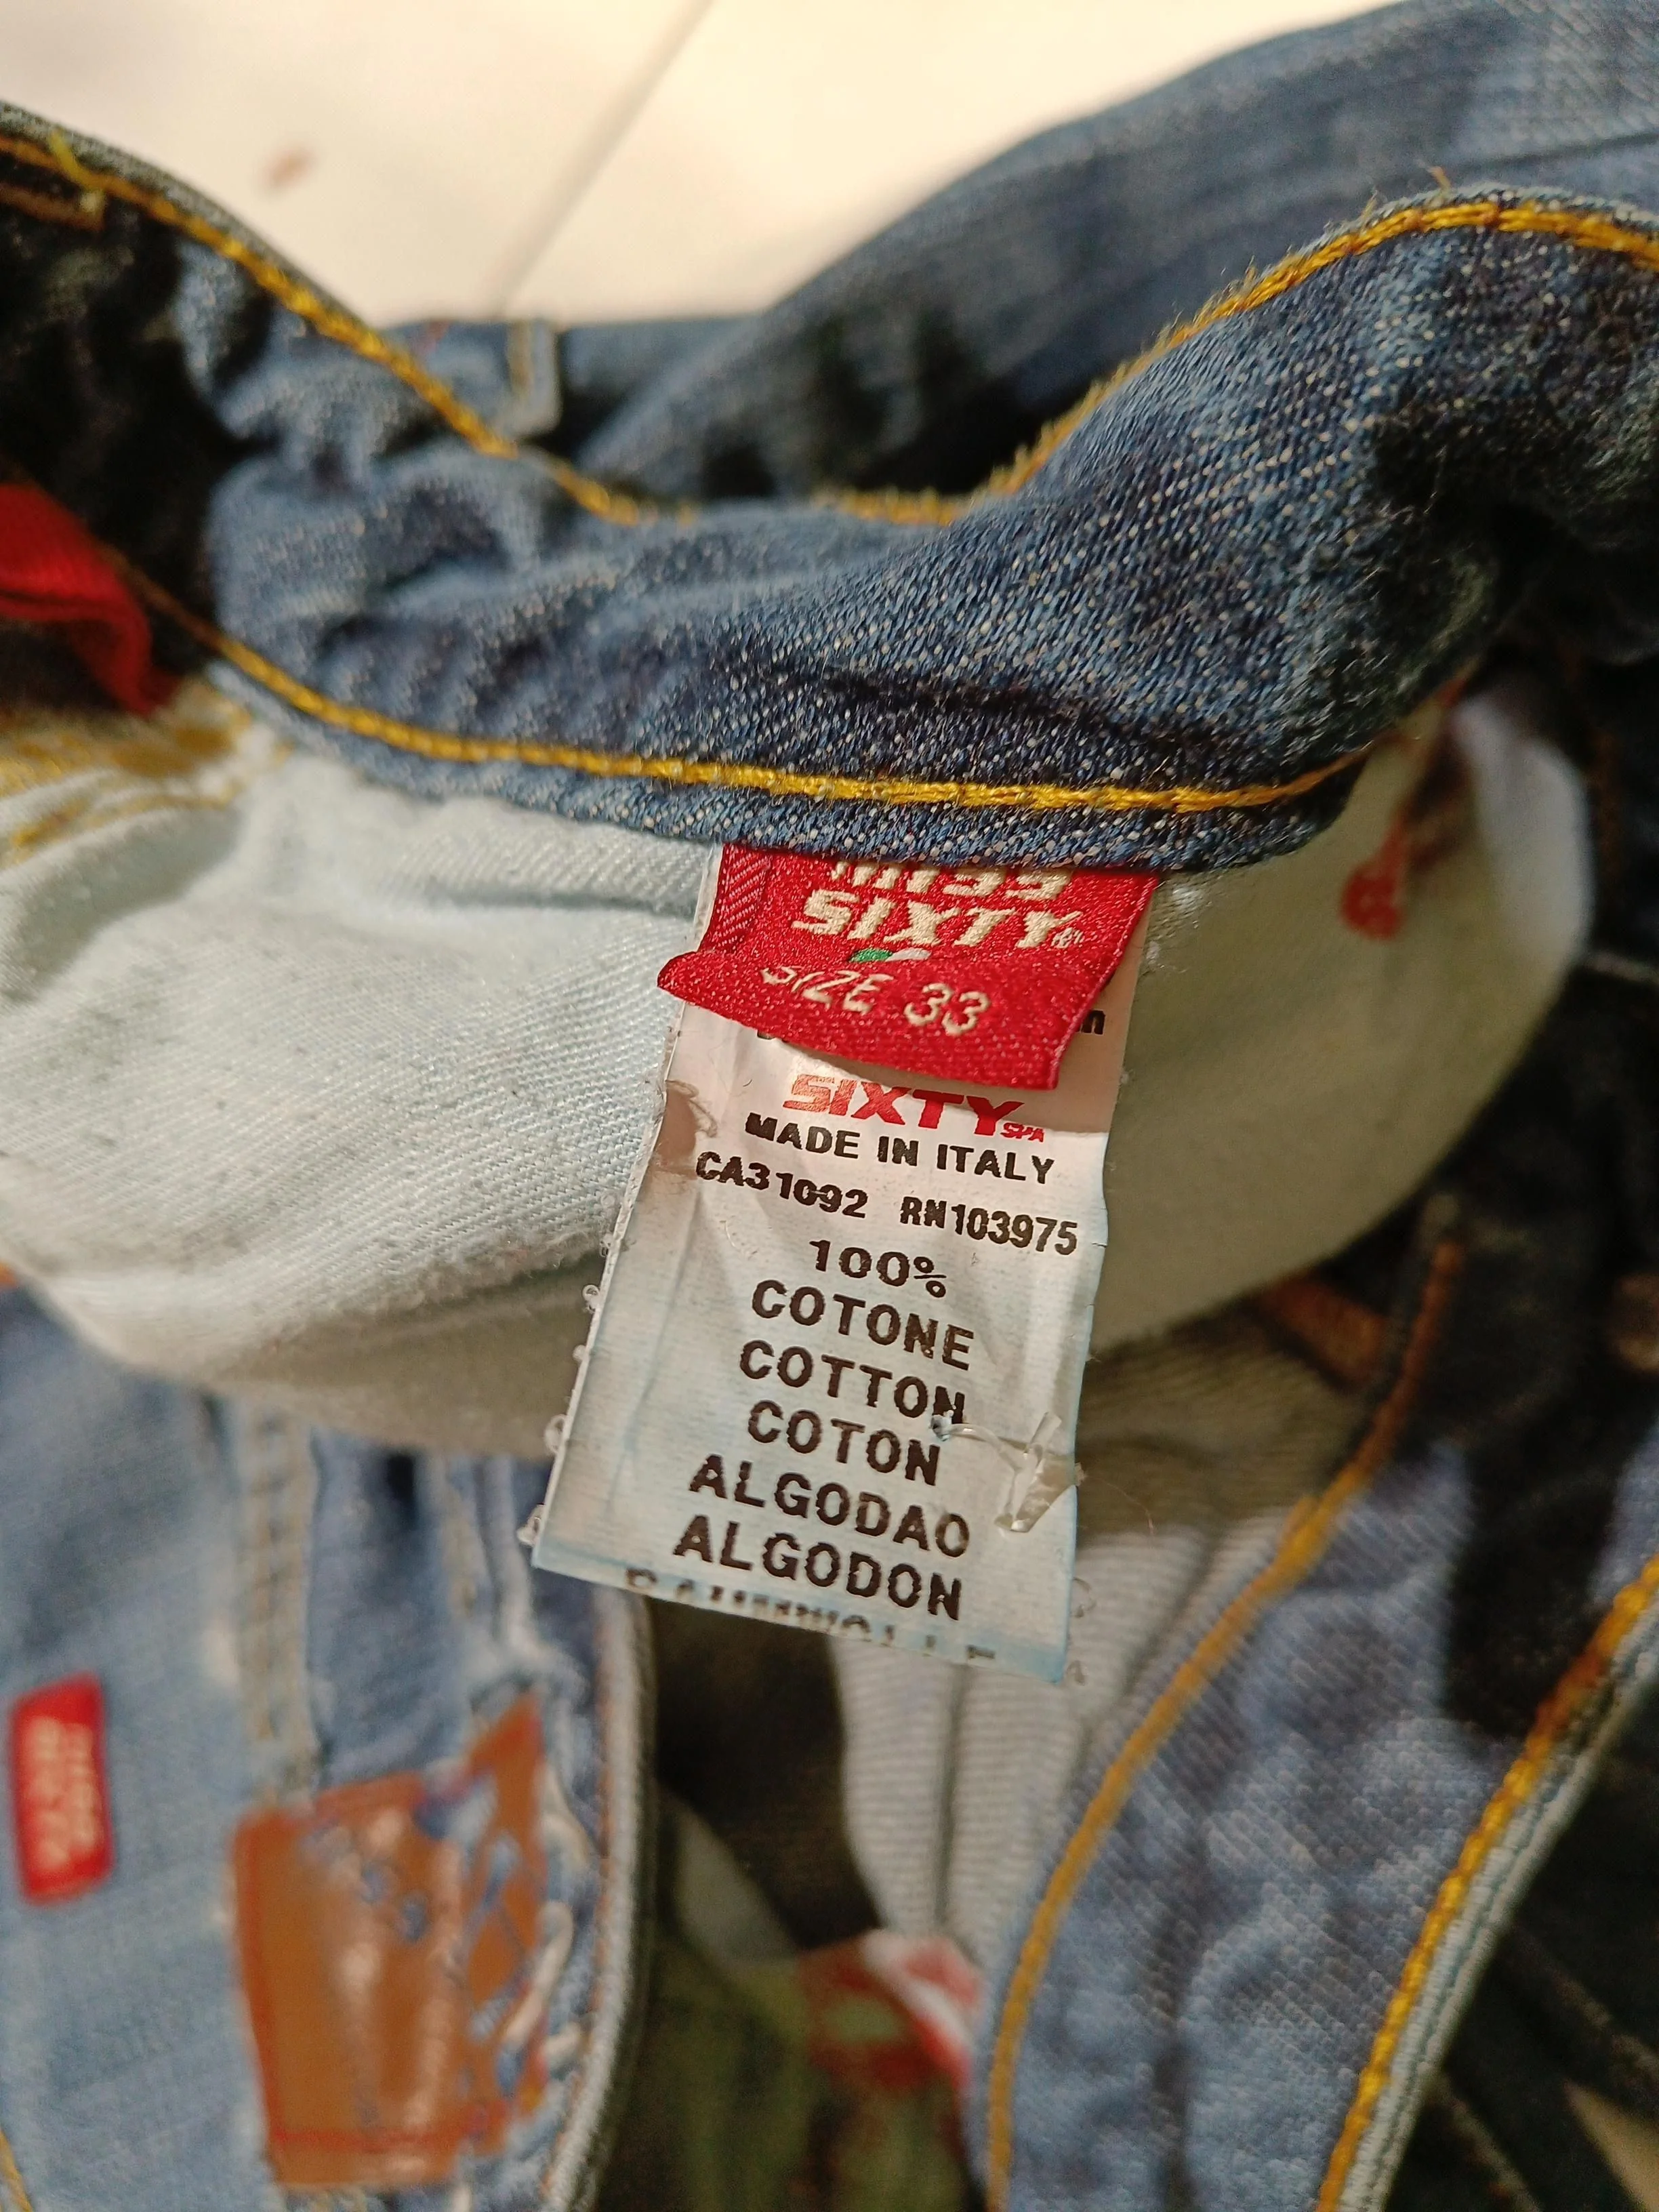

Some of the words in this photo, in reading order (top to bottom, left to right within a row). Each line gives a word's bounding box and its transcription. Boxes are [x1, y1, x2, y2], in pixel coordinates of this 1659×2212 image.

[760, 965, 894, 1015] SIZE
[904, 983, 990, 1036] 33
[745, 1112, 861, 1160] MADE
[877, 1136, 919, 1167] IN
[937, 1144, 1055, 1185] ITALY
[783, 1073, 1025, 1136] SIXTY
[1000, 1122, 1044, 1143] SPA
[695, 1151, 869, 1219] CA31092
[899, 1196, 1078, 1256] RN103975
[809, 1240, 947, 1298] 100%
[752, 1279, 974, 1371] COTONE
[739, 1340, 966, 1426] COTTON
[747, 1400, 941, 1486] COTON
[689, 1454, 970, 1558] ALGODAO
[672, 1515, 962, 1621] ALGODON
